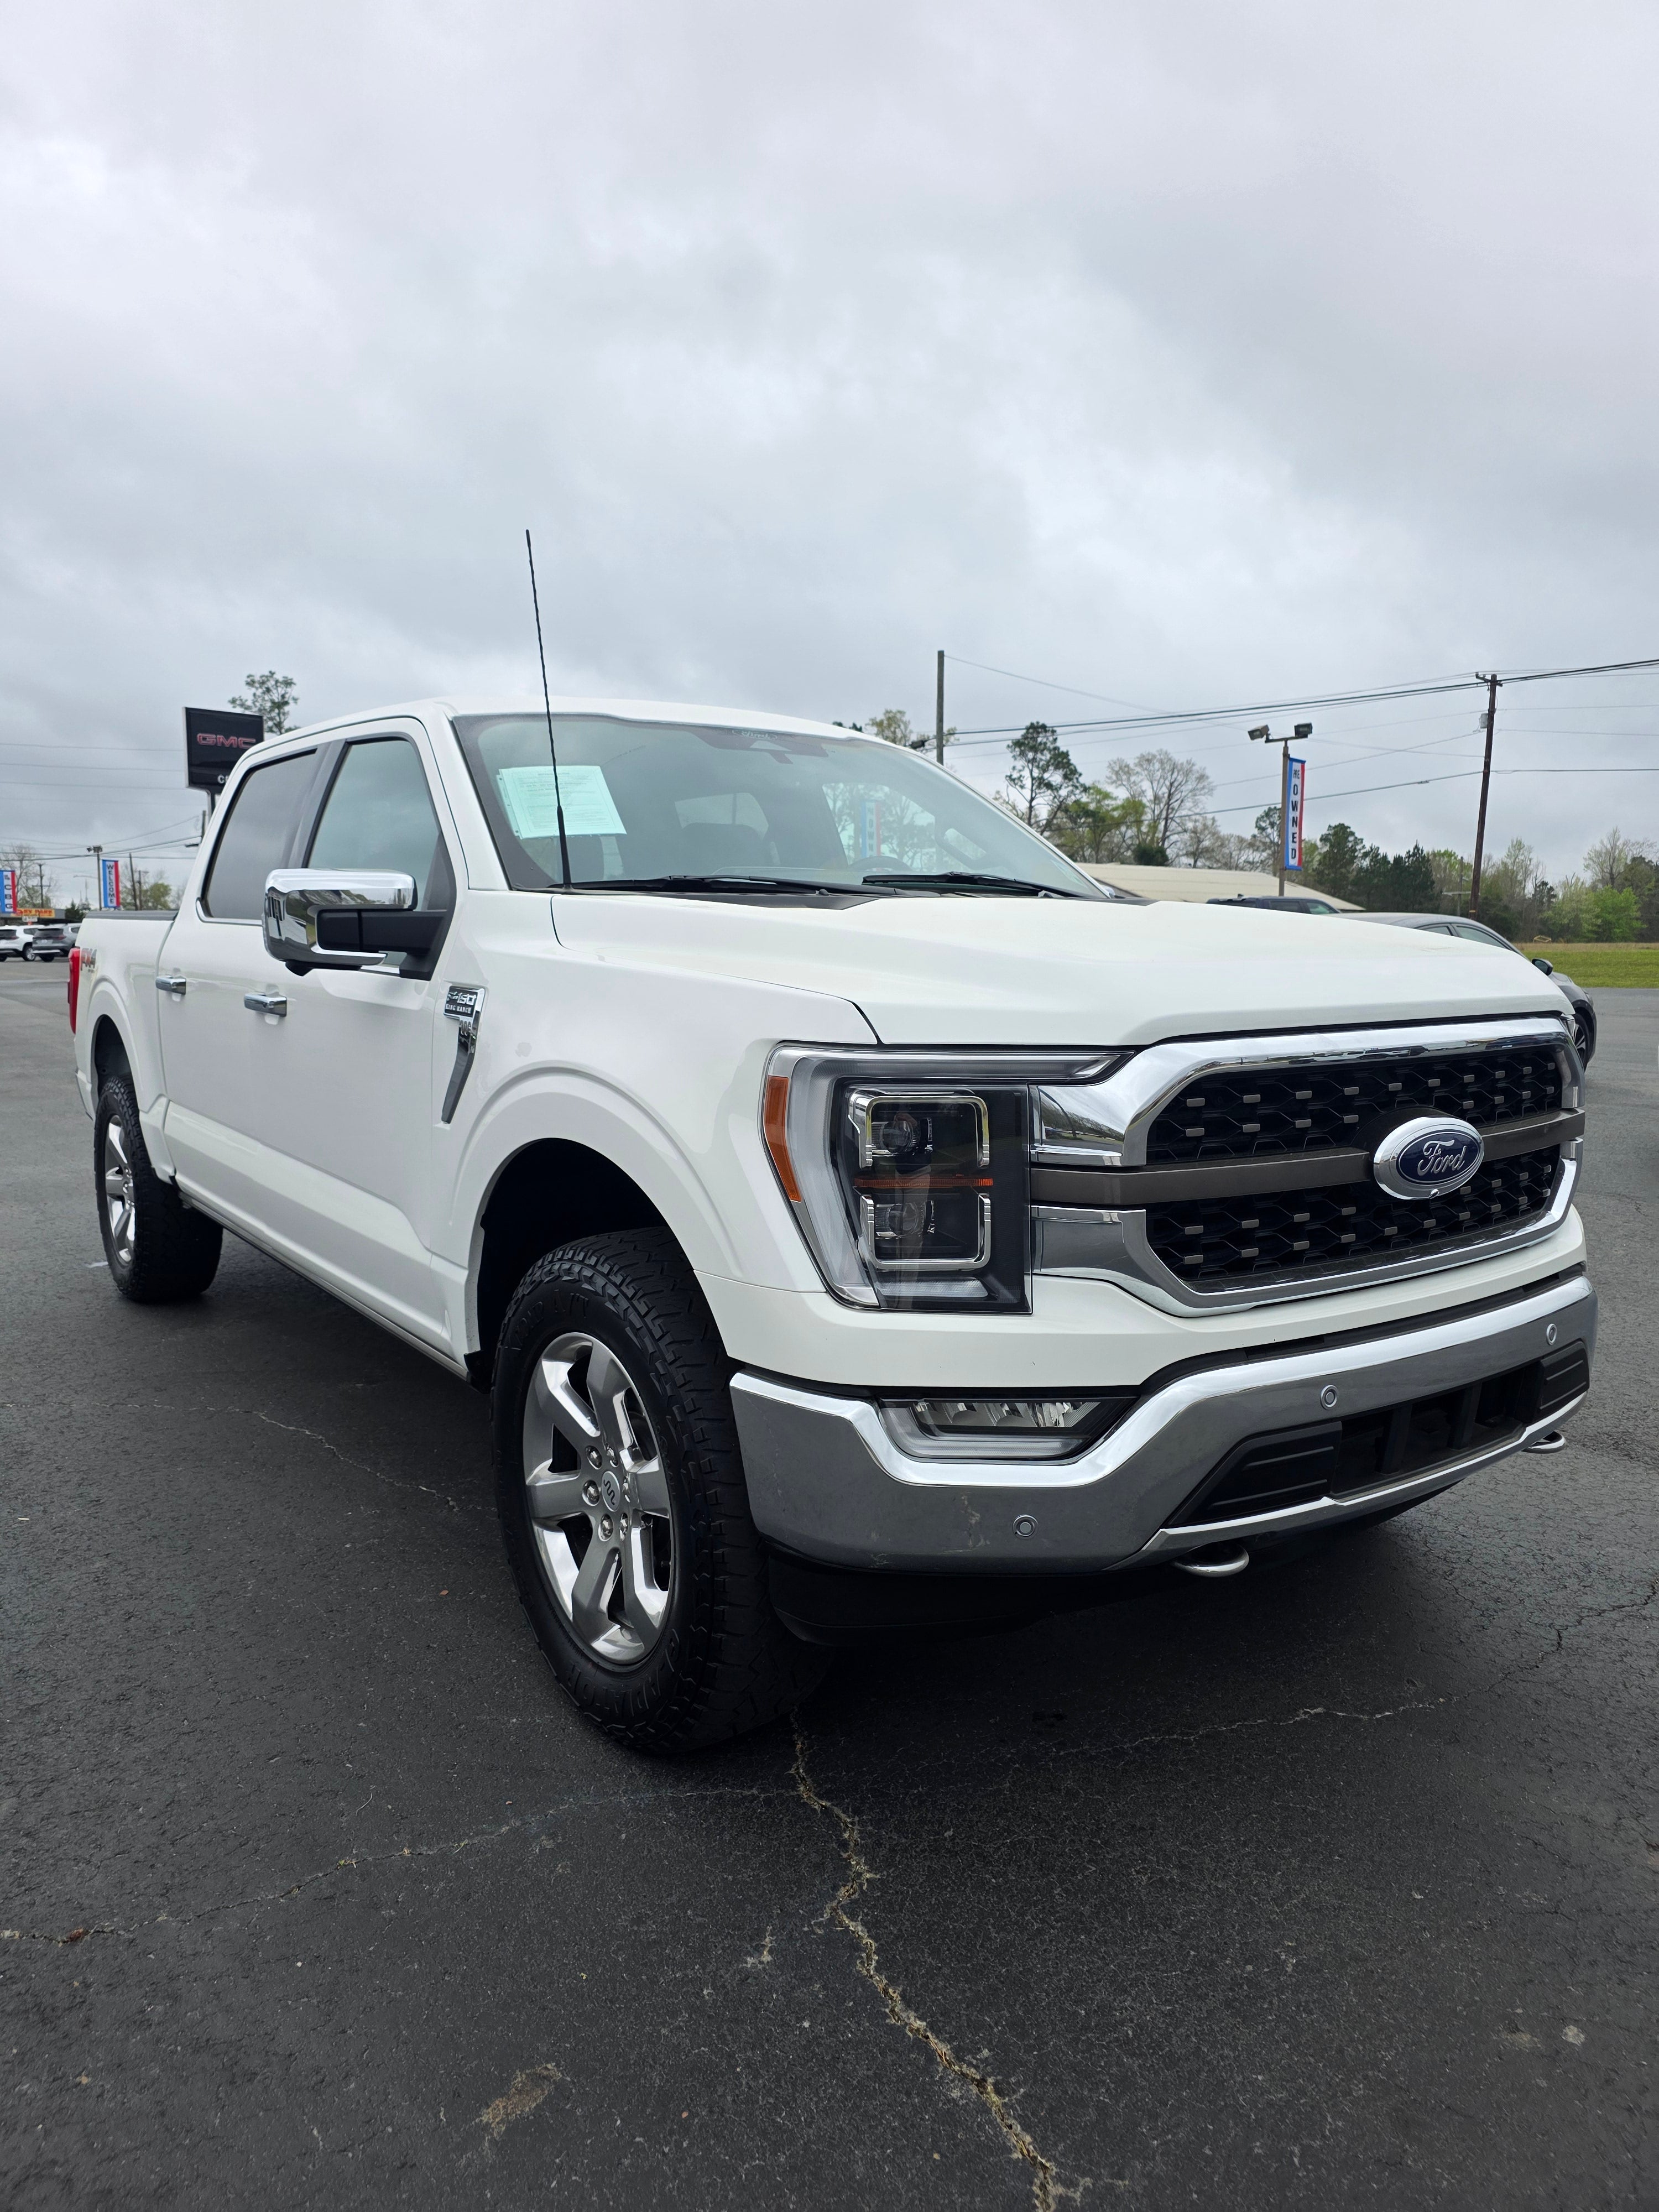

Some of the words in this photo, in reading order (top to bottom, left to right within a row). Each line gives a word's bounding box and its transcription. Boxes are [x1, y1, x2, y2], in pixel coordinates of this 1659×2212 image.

[197, 733, 256, 749] GMC
[107, 864, 115, 904] WELCOME
[1417, 1139, 1467, 1176] Ford
